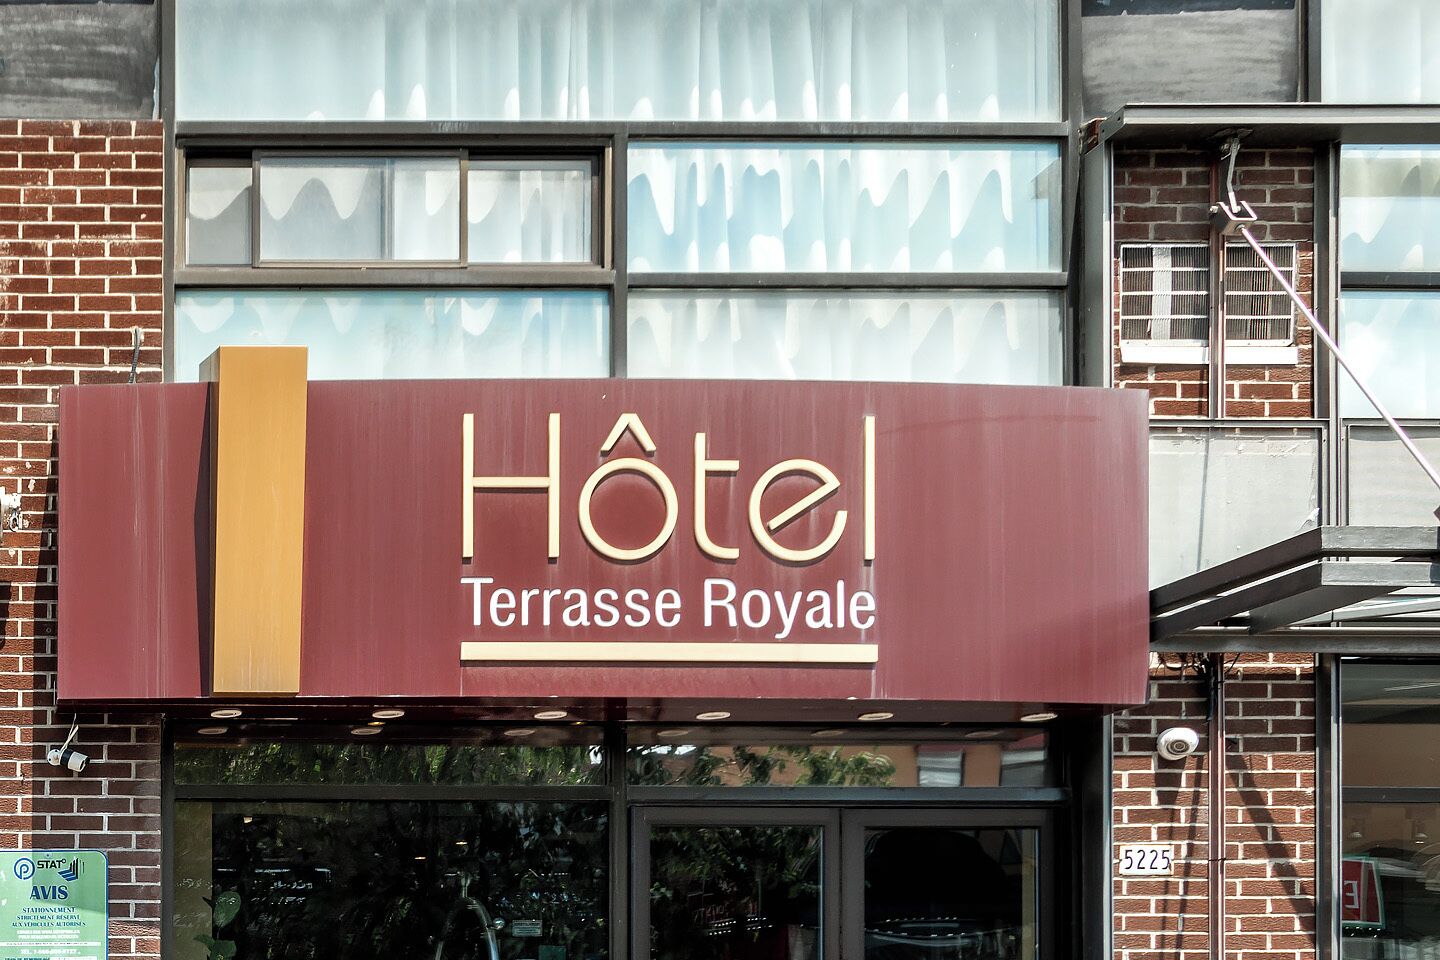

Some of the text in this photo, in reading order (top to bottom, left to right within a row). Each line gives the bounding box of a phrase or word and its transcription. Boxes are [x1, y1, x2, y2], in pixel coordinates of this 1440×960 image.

[462, 412, 876, 561] Hôtel
[460, 577, 877, 640] Terrasse Royale
[1124, 849, 1170, 870] 5225
[30, 885, 68, 900] AVIS
